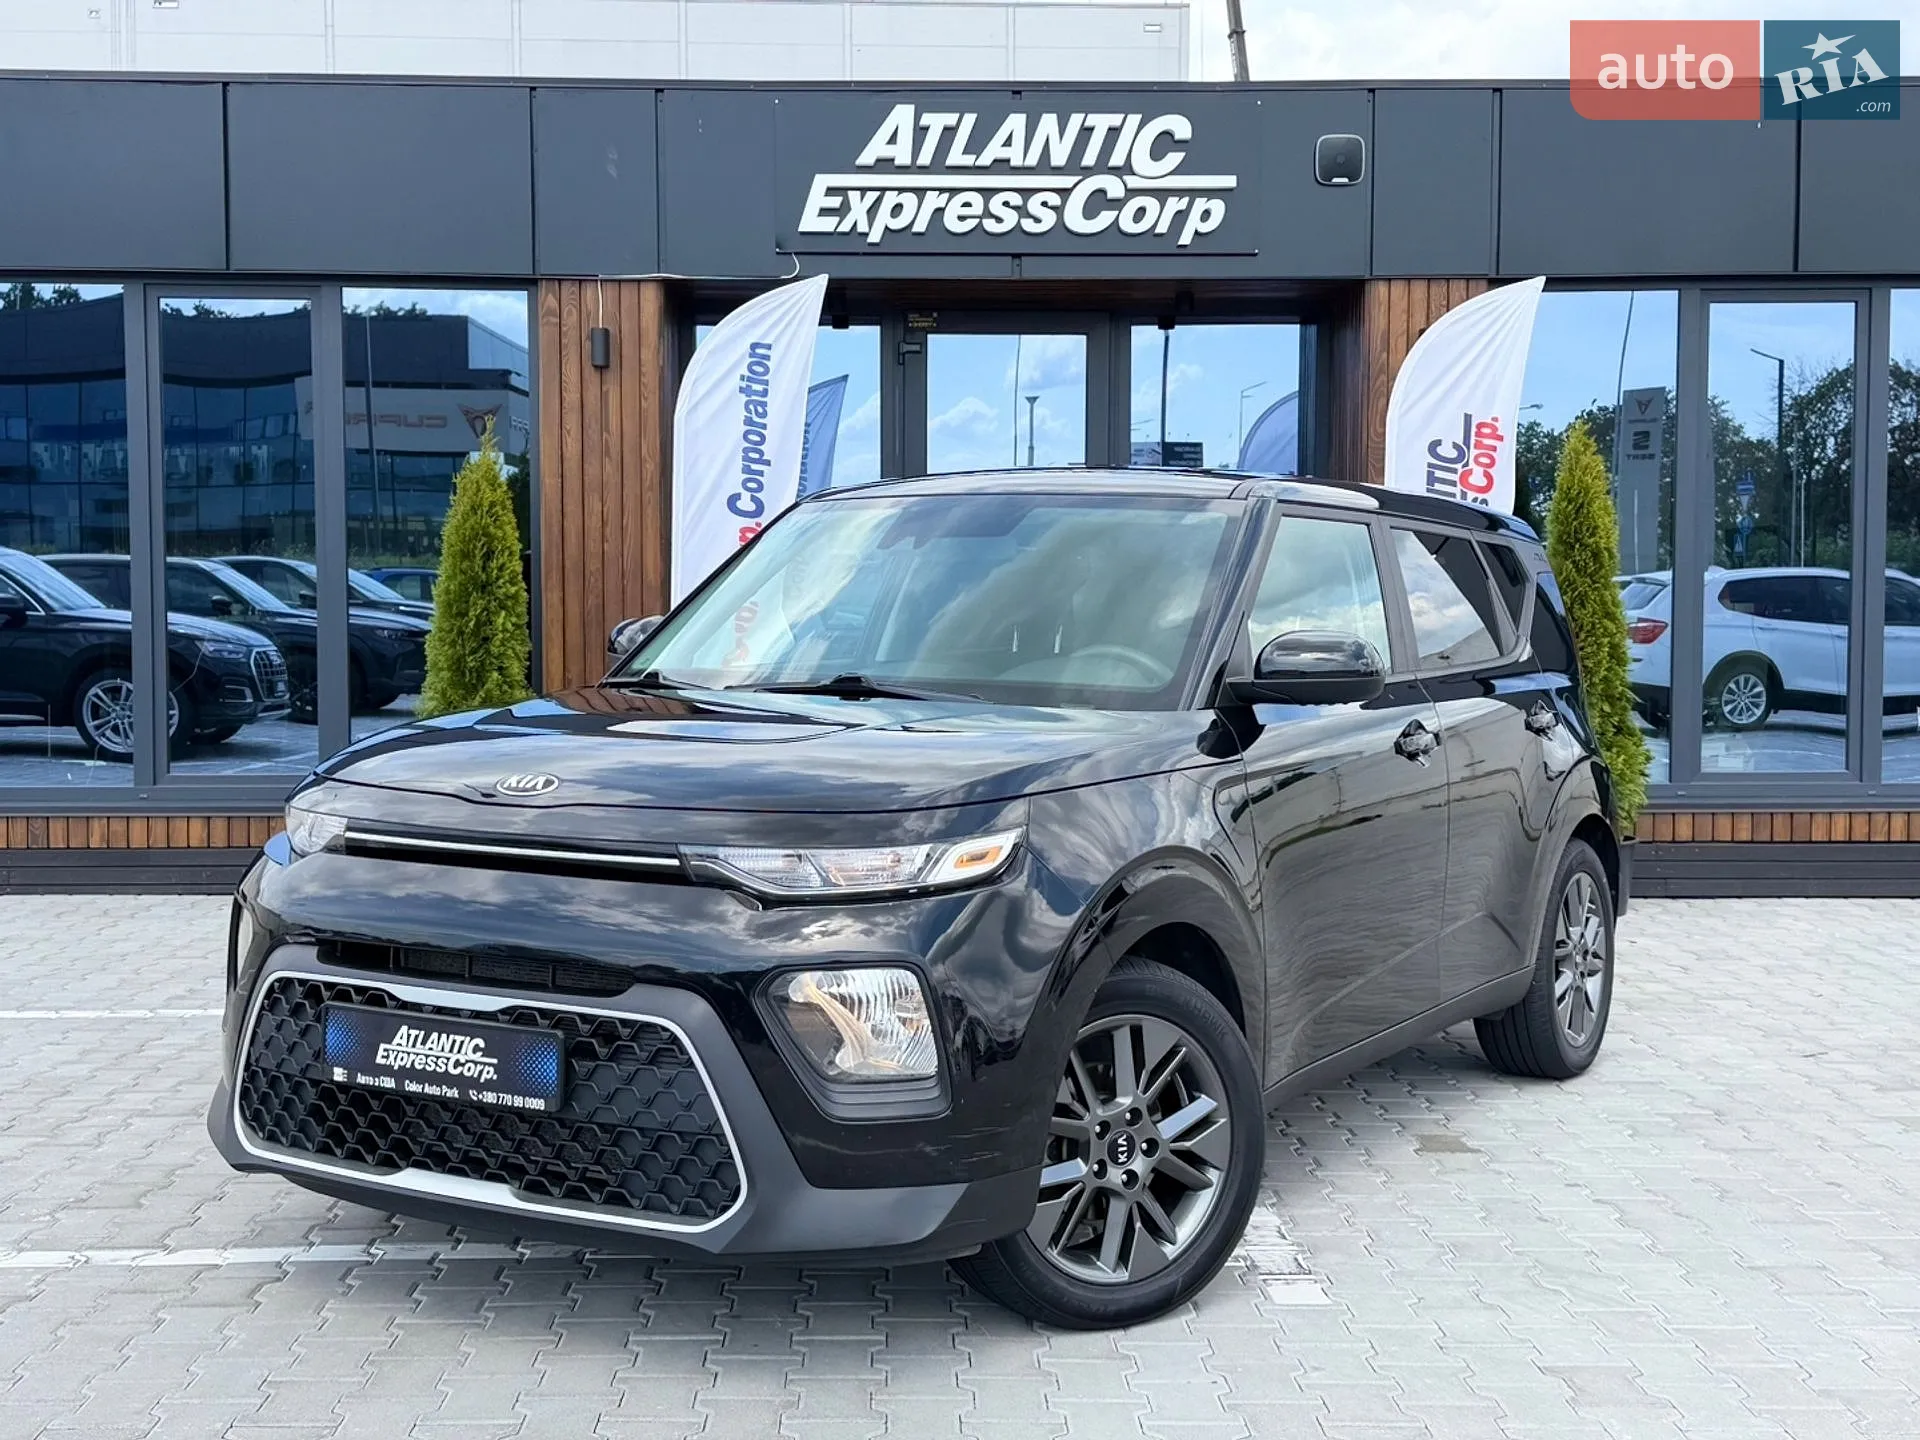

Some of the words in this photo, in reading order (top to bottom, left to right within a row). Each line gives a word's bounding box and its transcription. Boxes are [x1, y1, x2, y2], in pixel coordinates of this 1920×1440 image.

[855, 103, 1192, 178] ATLANTIC
[798, 174, 1226, 247] ExpressCorp
[726, 341, 773, 519] Corporation
[503, 775, 547, 790] KIA
[392, 1025, 486, 1059] ATLANTIC
[375, 1044, 498, 1083] ExpressCorp.
[404, 1079, 423, 1093] Color
[423, 1083, 441, 1096] Auto
[441, 1086, 459, 1099] Park
[1117, 1134, 1128, 1163] KIA
